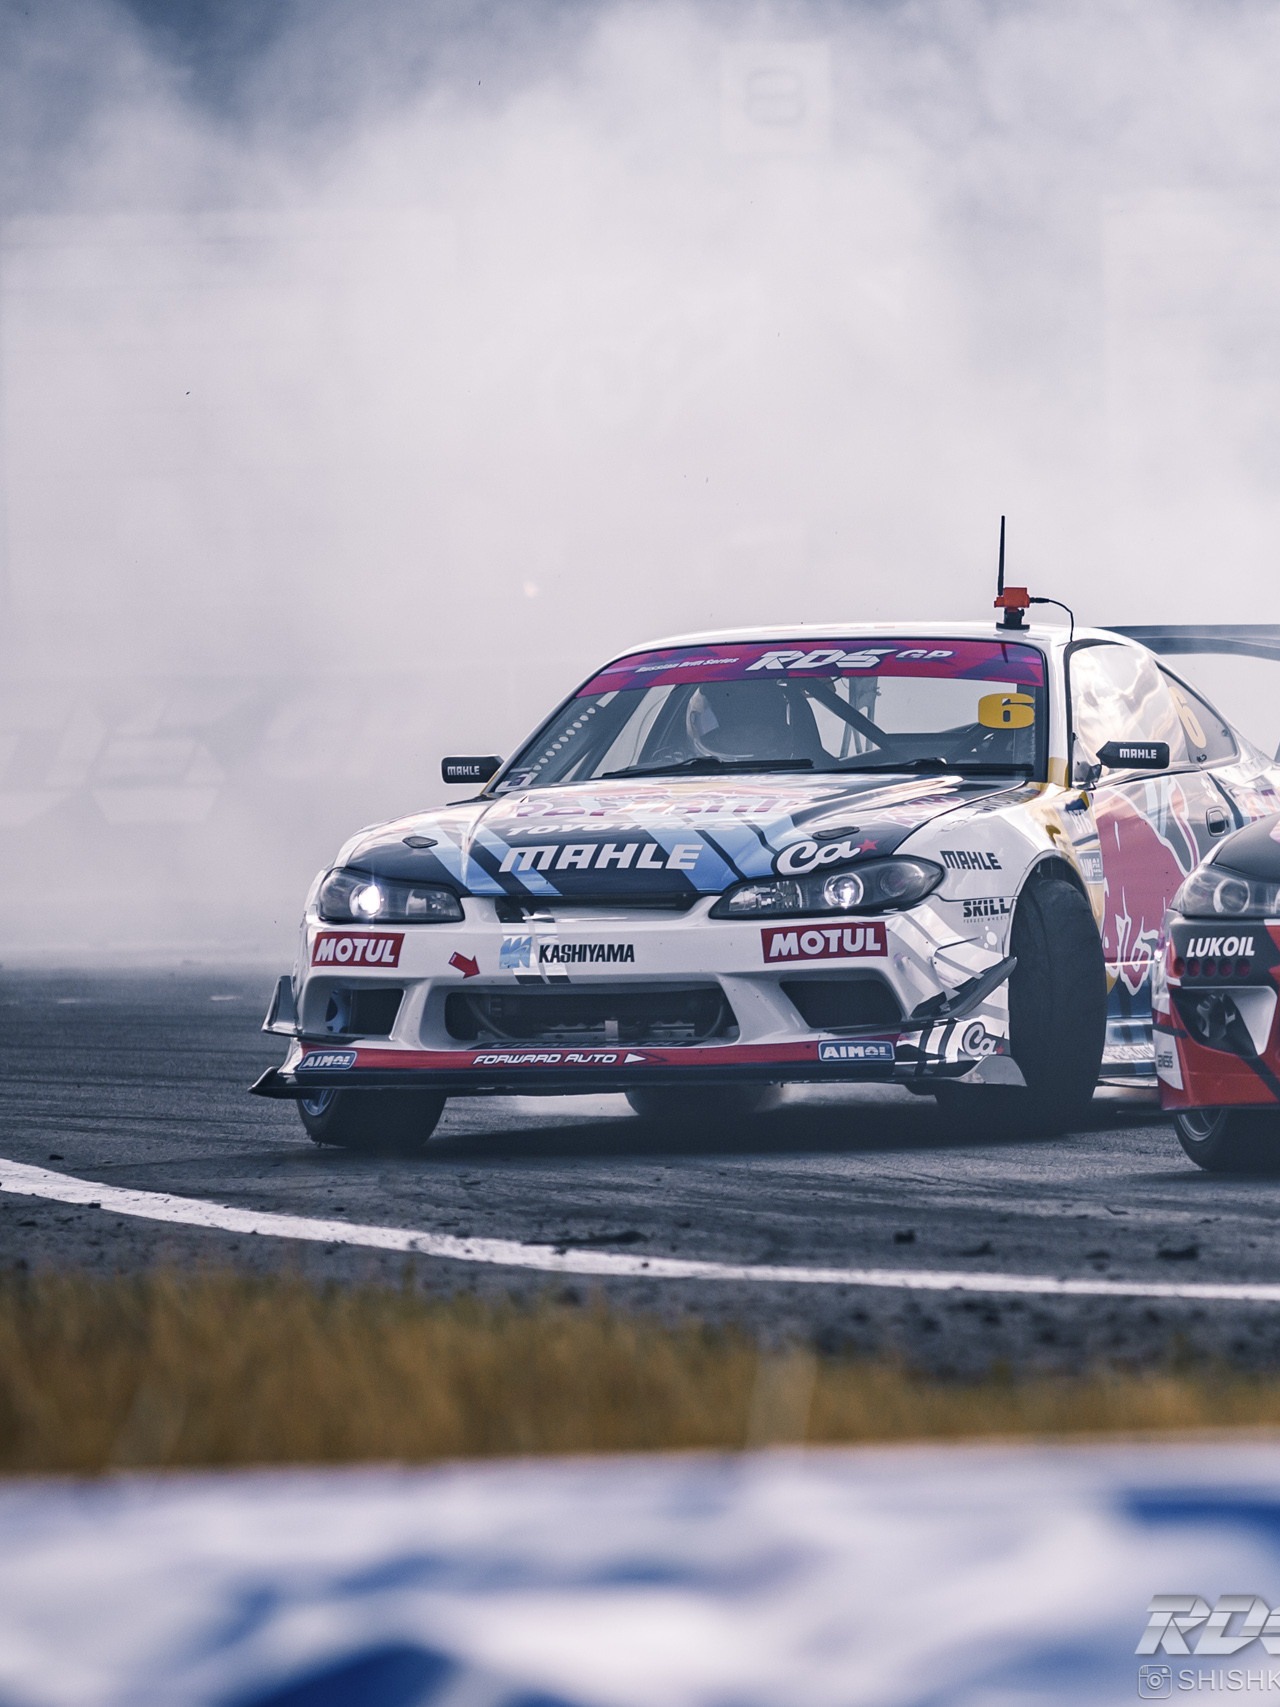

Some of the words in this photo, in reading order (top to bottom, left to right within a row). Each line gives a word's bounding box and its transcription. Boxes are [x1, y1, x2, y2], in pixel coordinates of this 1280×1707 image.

[745, 648, 899, 672] RDS
[895, 649, 953, 661] GP
[978, 692, 1035, 729] 6
[1119, 748, 1158, 760] MAHLE
[447, 764, 481, 777] MAHLE
[505, 822, 617, 837] TOYO
[498, 842, 704, 873] MAHLE
[939, 850, 1003, 871] MAHLE
[963, 898, 1011, 918] SKILL
[314, 937, 397, 963] MOTUL
[769, 927, 882, 958] MOTUL
[1186, 936, 1256, 958] LUKOIL
[538, 943, 636, 964] KASHIYAMA
[472, 1053, 563, 1066] FORWARD
[564, 1053, 618, 1064] AUTO
